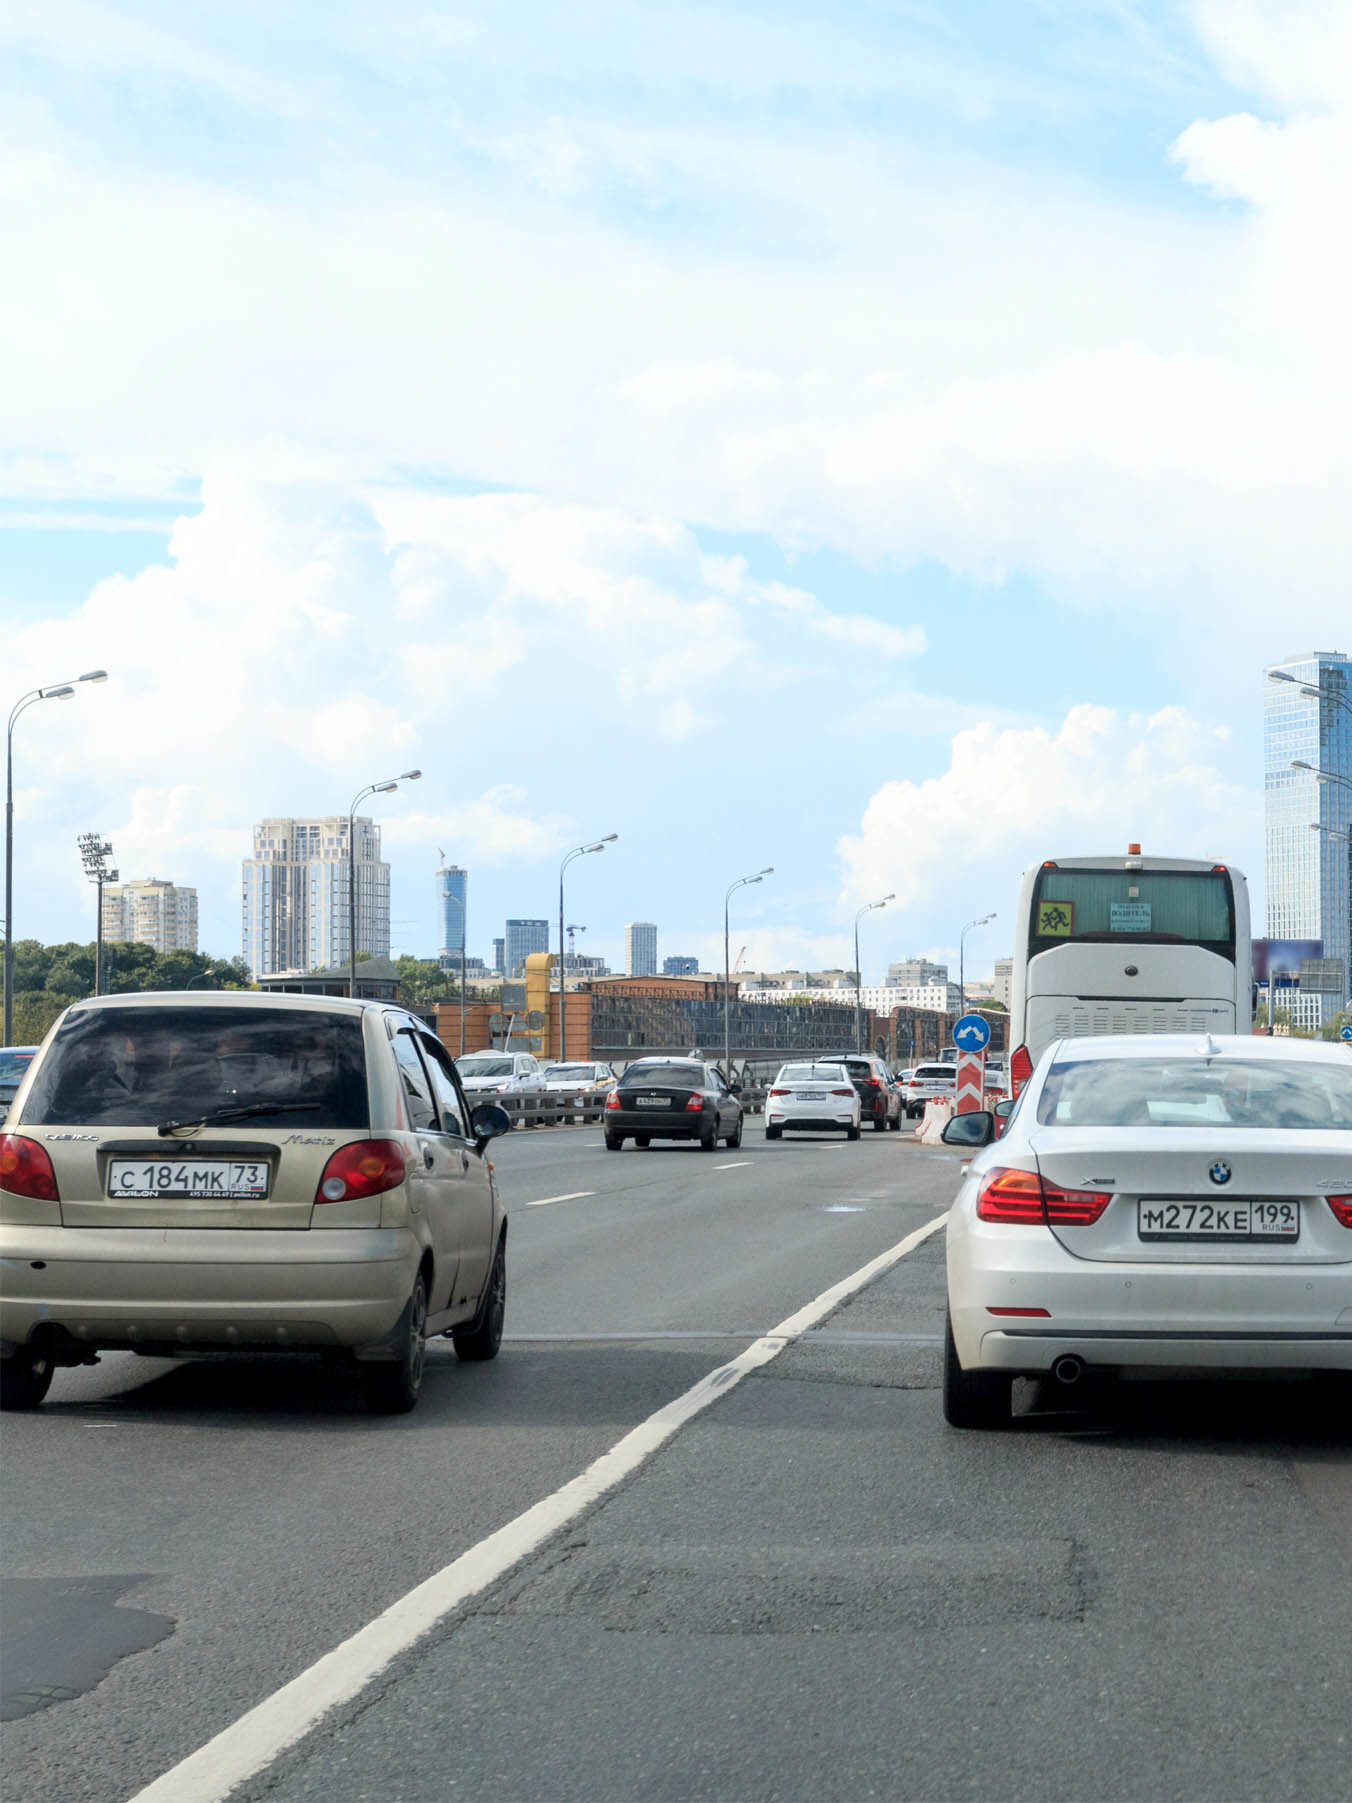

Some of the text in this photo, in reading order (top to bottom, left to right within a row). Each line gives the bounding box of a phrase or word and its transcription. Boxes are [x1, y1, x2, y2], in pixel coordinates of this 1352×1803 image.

[234, 1165, 259, 1183] 73
[1254, 1204, 1291, 1223] 199
[1261, 1223, 1280, 1231] RUS
